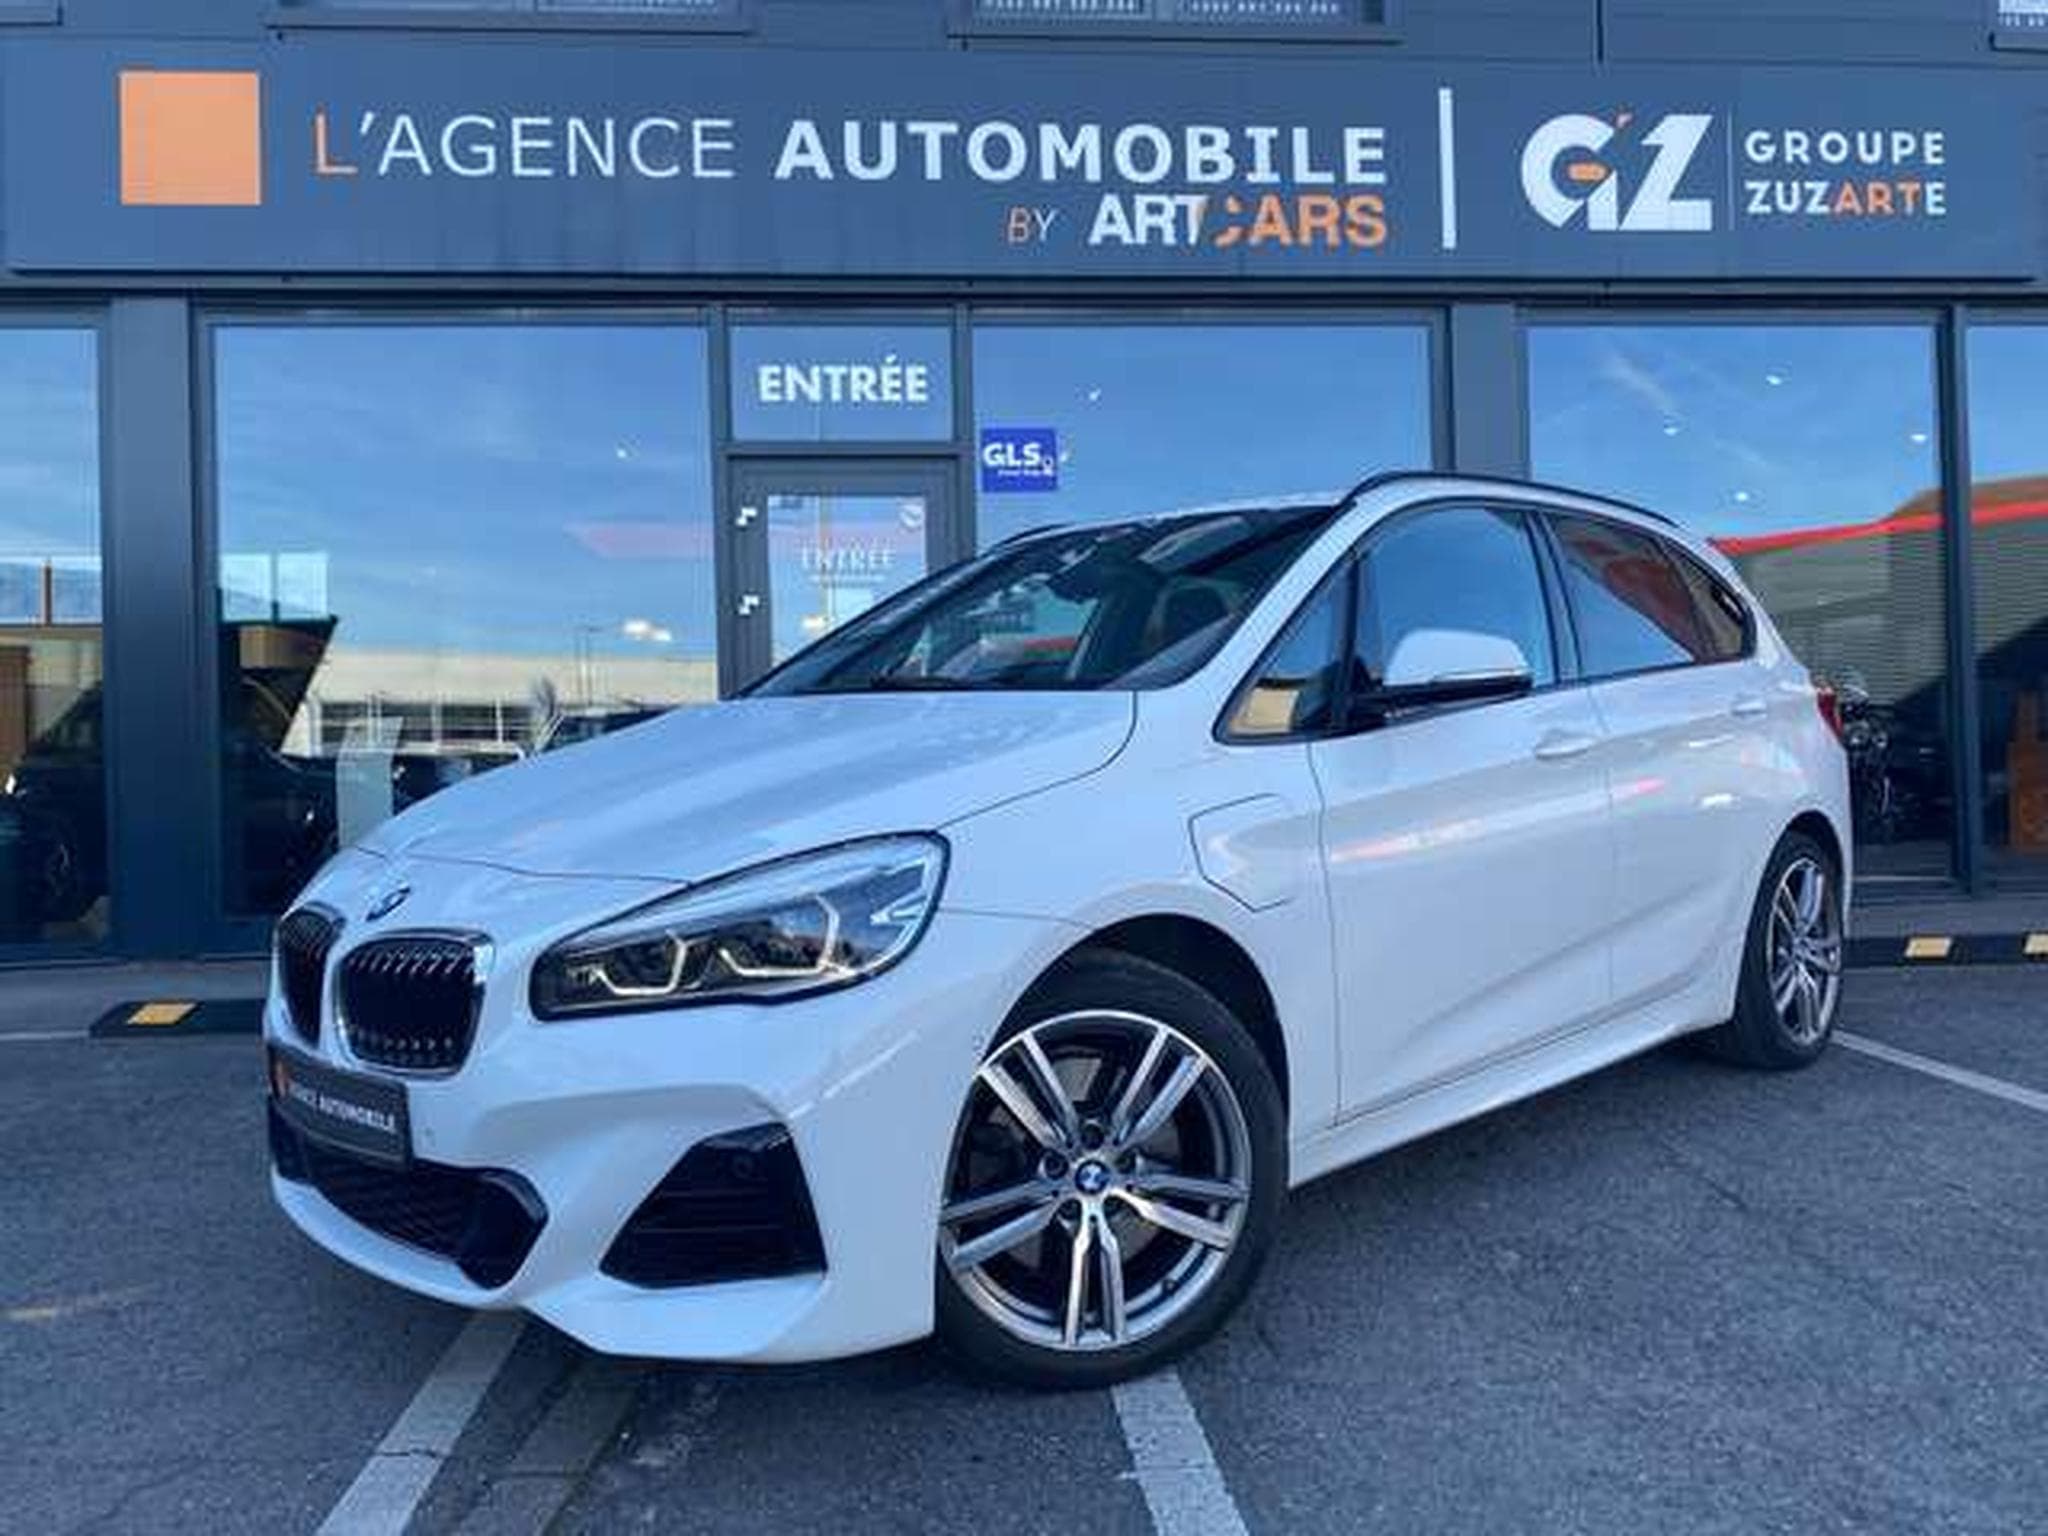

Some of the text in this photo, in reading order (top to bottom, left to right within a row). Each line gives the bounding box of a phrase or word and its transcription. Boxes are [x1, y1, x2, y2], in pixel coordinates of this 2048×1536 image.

[314, 110, 1386, 184] L'AGENCE AUTOMOBILE
[1744, 130, 1945, 165] GROUPE
[1744, 180, 1947, 216] ZUZARTE
[1007, 208, 1055, 244] BY
[758, 354, 929, 402] ENTRÉE
[983, 443, 1041, 467] GLS
